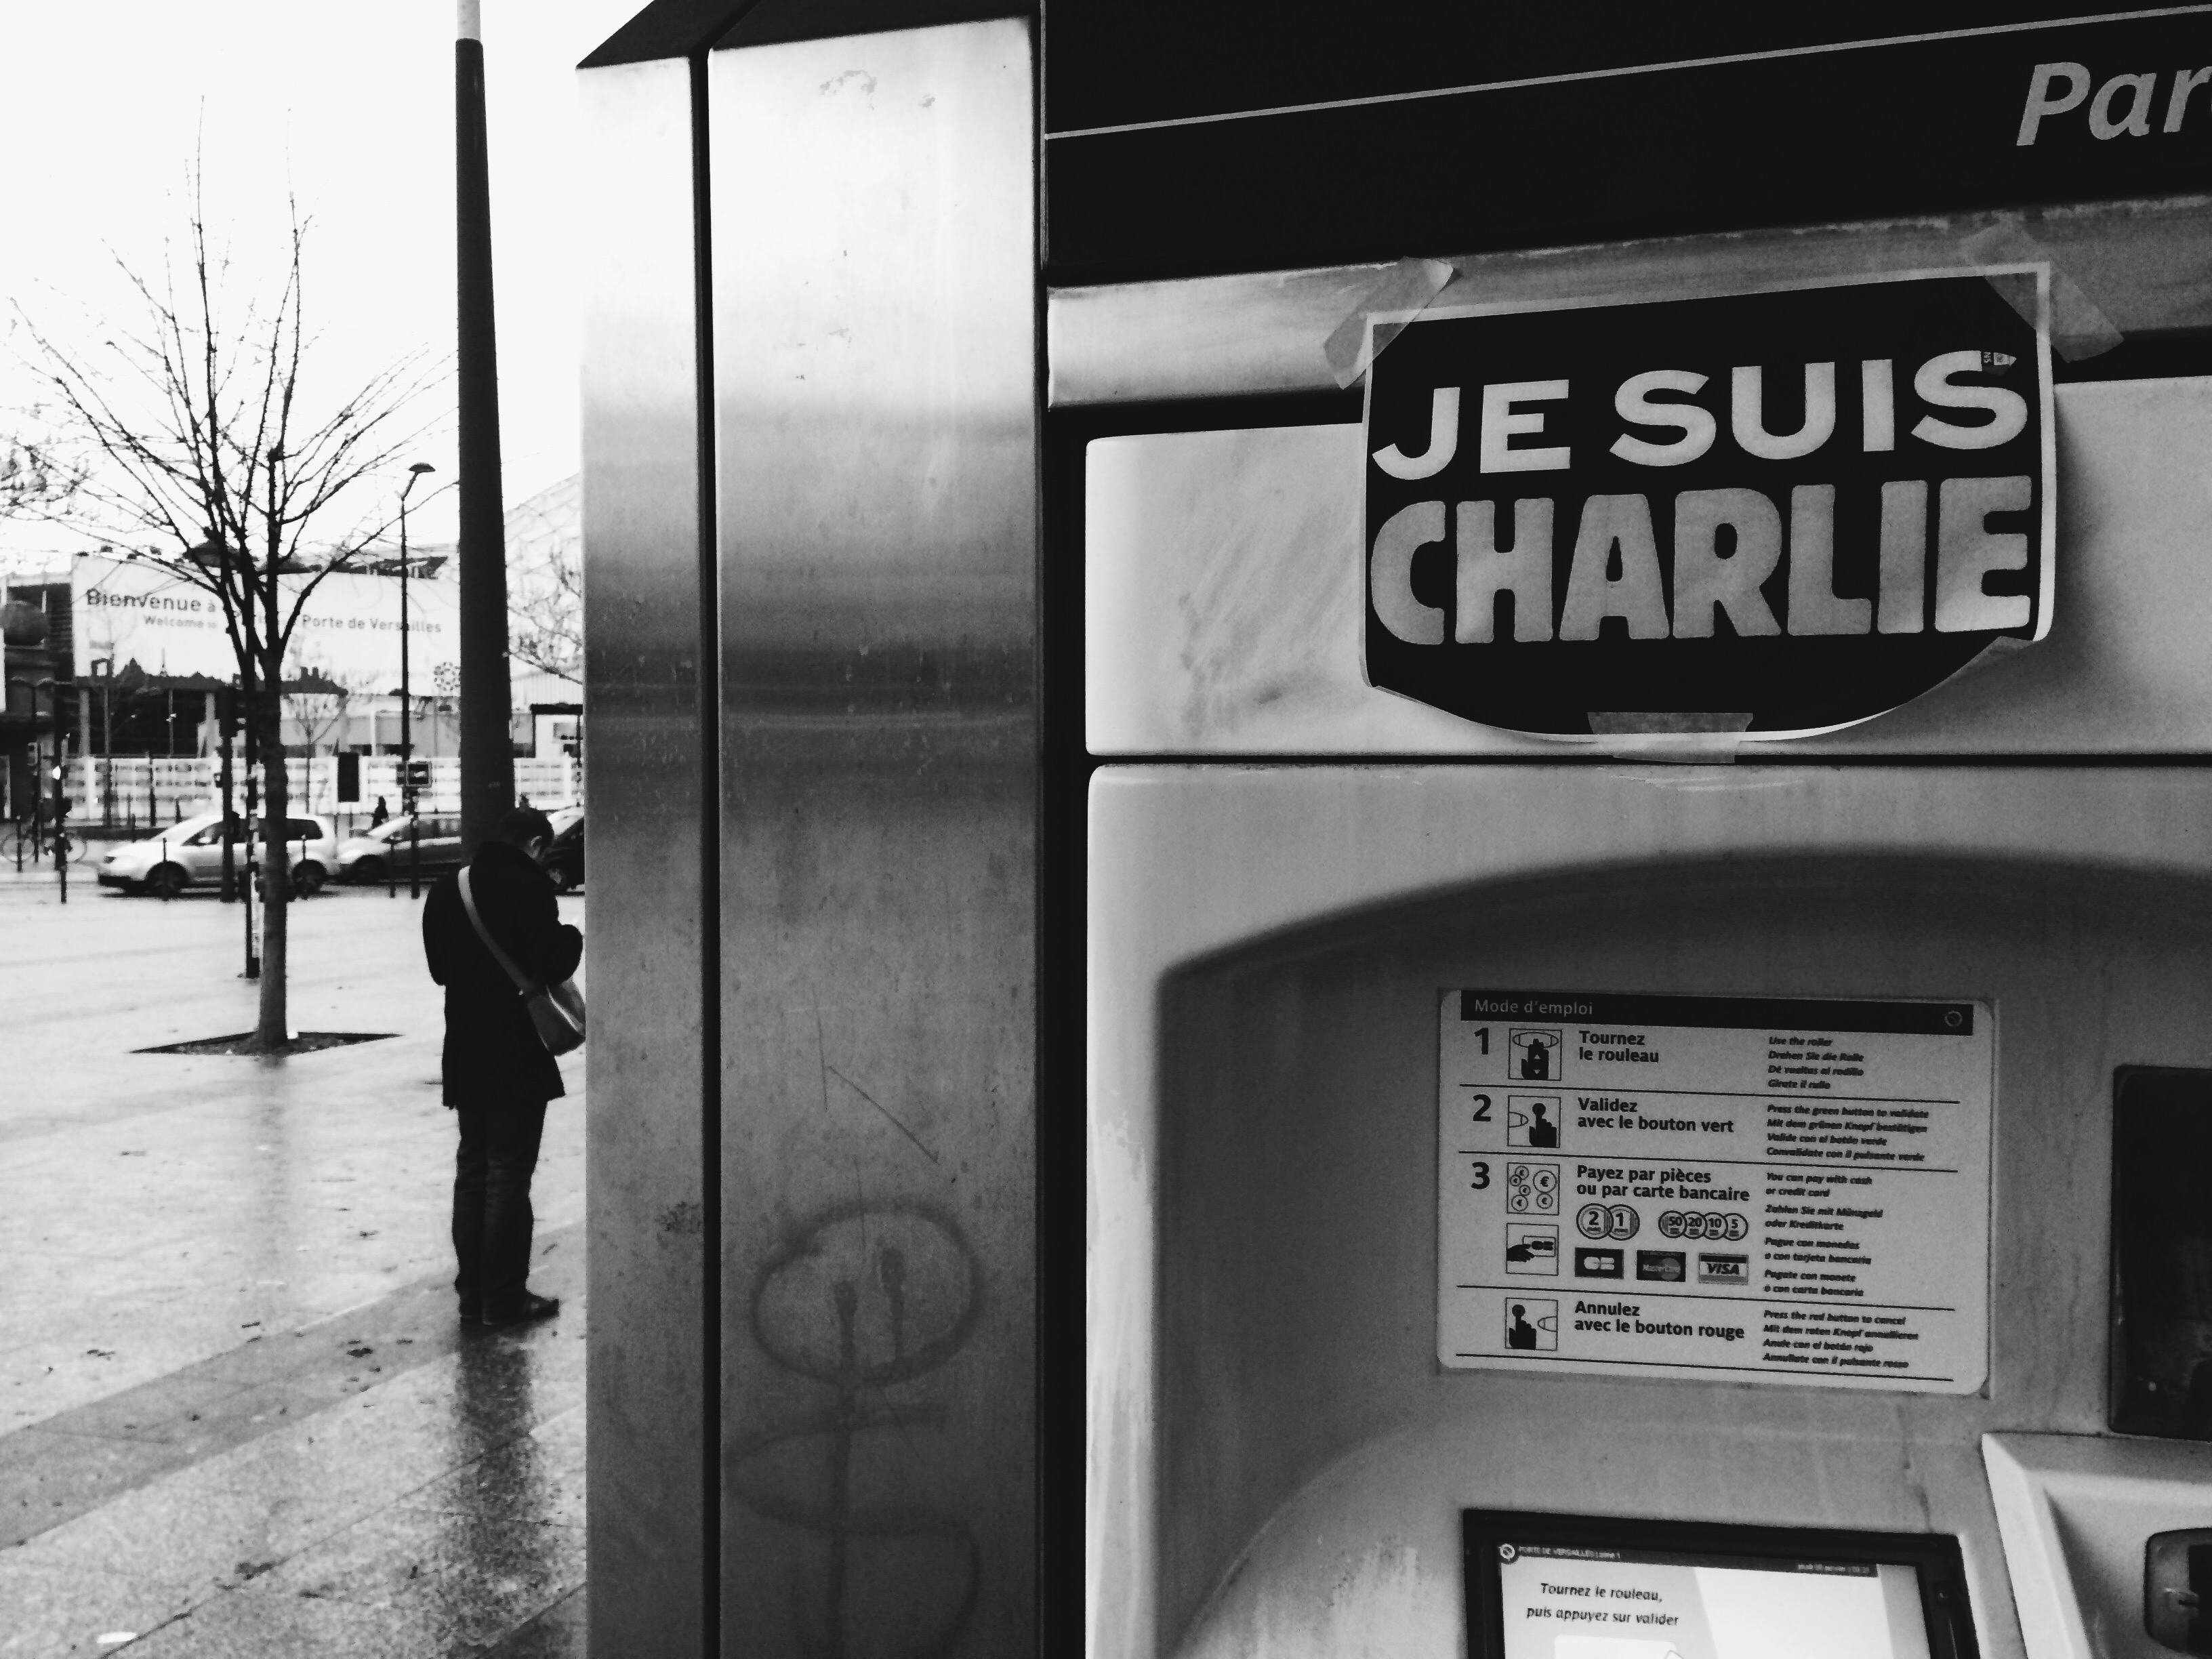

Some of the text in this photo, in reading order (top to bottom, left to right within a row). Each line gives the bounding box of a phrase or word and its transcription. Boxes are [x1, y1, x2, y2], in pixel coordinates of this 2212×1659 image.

[2017, 62, 2212, 146] Par
[1372, 349, 2028, 480] JE SUIS
[1370, 475, 2032, 645] CHARLIE
[86, 588, 201, 611] Bienvenue
[143, 615, 203, 628] Welcome
[302, 614, 343, 628] Porte
[348, 618, 365, 629] de
[369, 618, 441, 632] Versilles
[1475, 999, 1518, 1013] Mode
[1474, 1027, 1488, 1054] 1
[1579, 1031, 1645, 1046] Tournez
[1579, 1047, 1659, 1063] le rouleau
[1473, 1094, 1491, 1122] 2
[1578, 1097, 1637, 1113] Validez
[1578, 1115, 1734, 1132] avec le bouton vert
[1471, 1162, 1490, 1189] 3
[1577, 1165, 1711, 1184] Payez par pièces
[1577, 1184, 1750, 1202] ou par carte bancaire
[1589, 1211, 1599, 1225] 2
[1616, 1212, 1624, 1227] 1
[1668, 1216, 1682, 1227] 50
[1688, 1217, 1702, 1227] 20
[1709, 1218, 1721, 1229] 10
[1731, 1218, 1738, 1229] 5
[1707, 1263, 1740, 1275] VISA
[1575, 1300, 1640, 1316] Annulez
[1574, 1319, 1744, 1341] avec le bouton rouge
[1541, 1582, 1662, 1603] Tournez le rouleau,
[1527, 1606, 1679, 1626] puis appuyez sur valider
